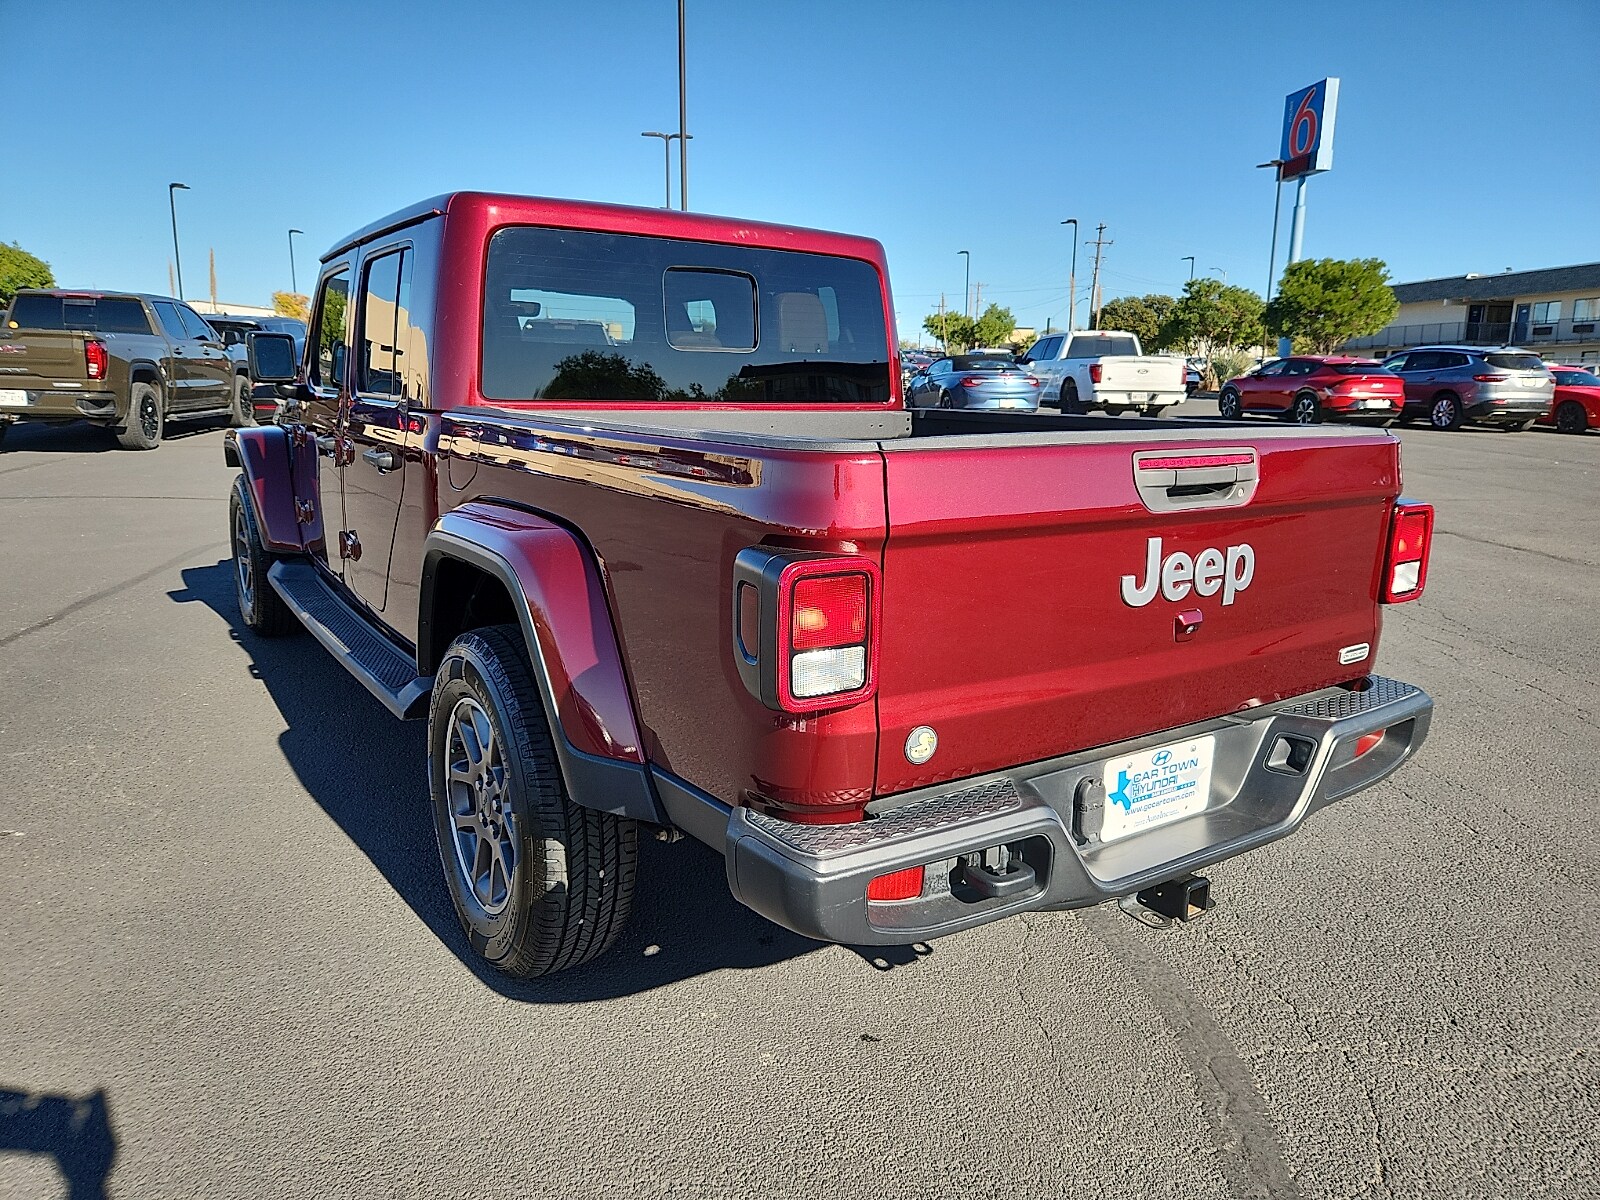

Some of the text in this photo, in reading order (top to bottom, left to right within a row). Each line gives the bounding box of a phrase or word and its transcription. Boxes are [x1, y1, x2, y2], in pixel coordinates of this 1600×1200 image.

[1288, 87, 1318, 159] 6
[1120, 537, 1256, 608] Jeep
[1132, 775, 1179, 797] HYUNDAI
[1133, 757, 1199, 783] CAR TOWN
